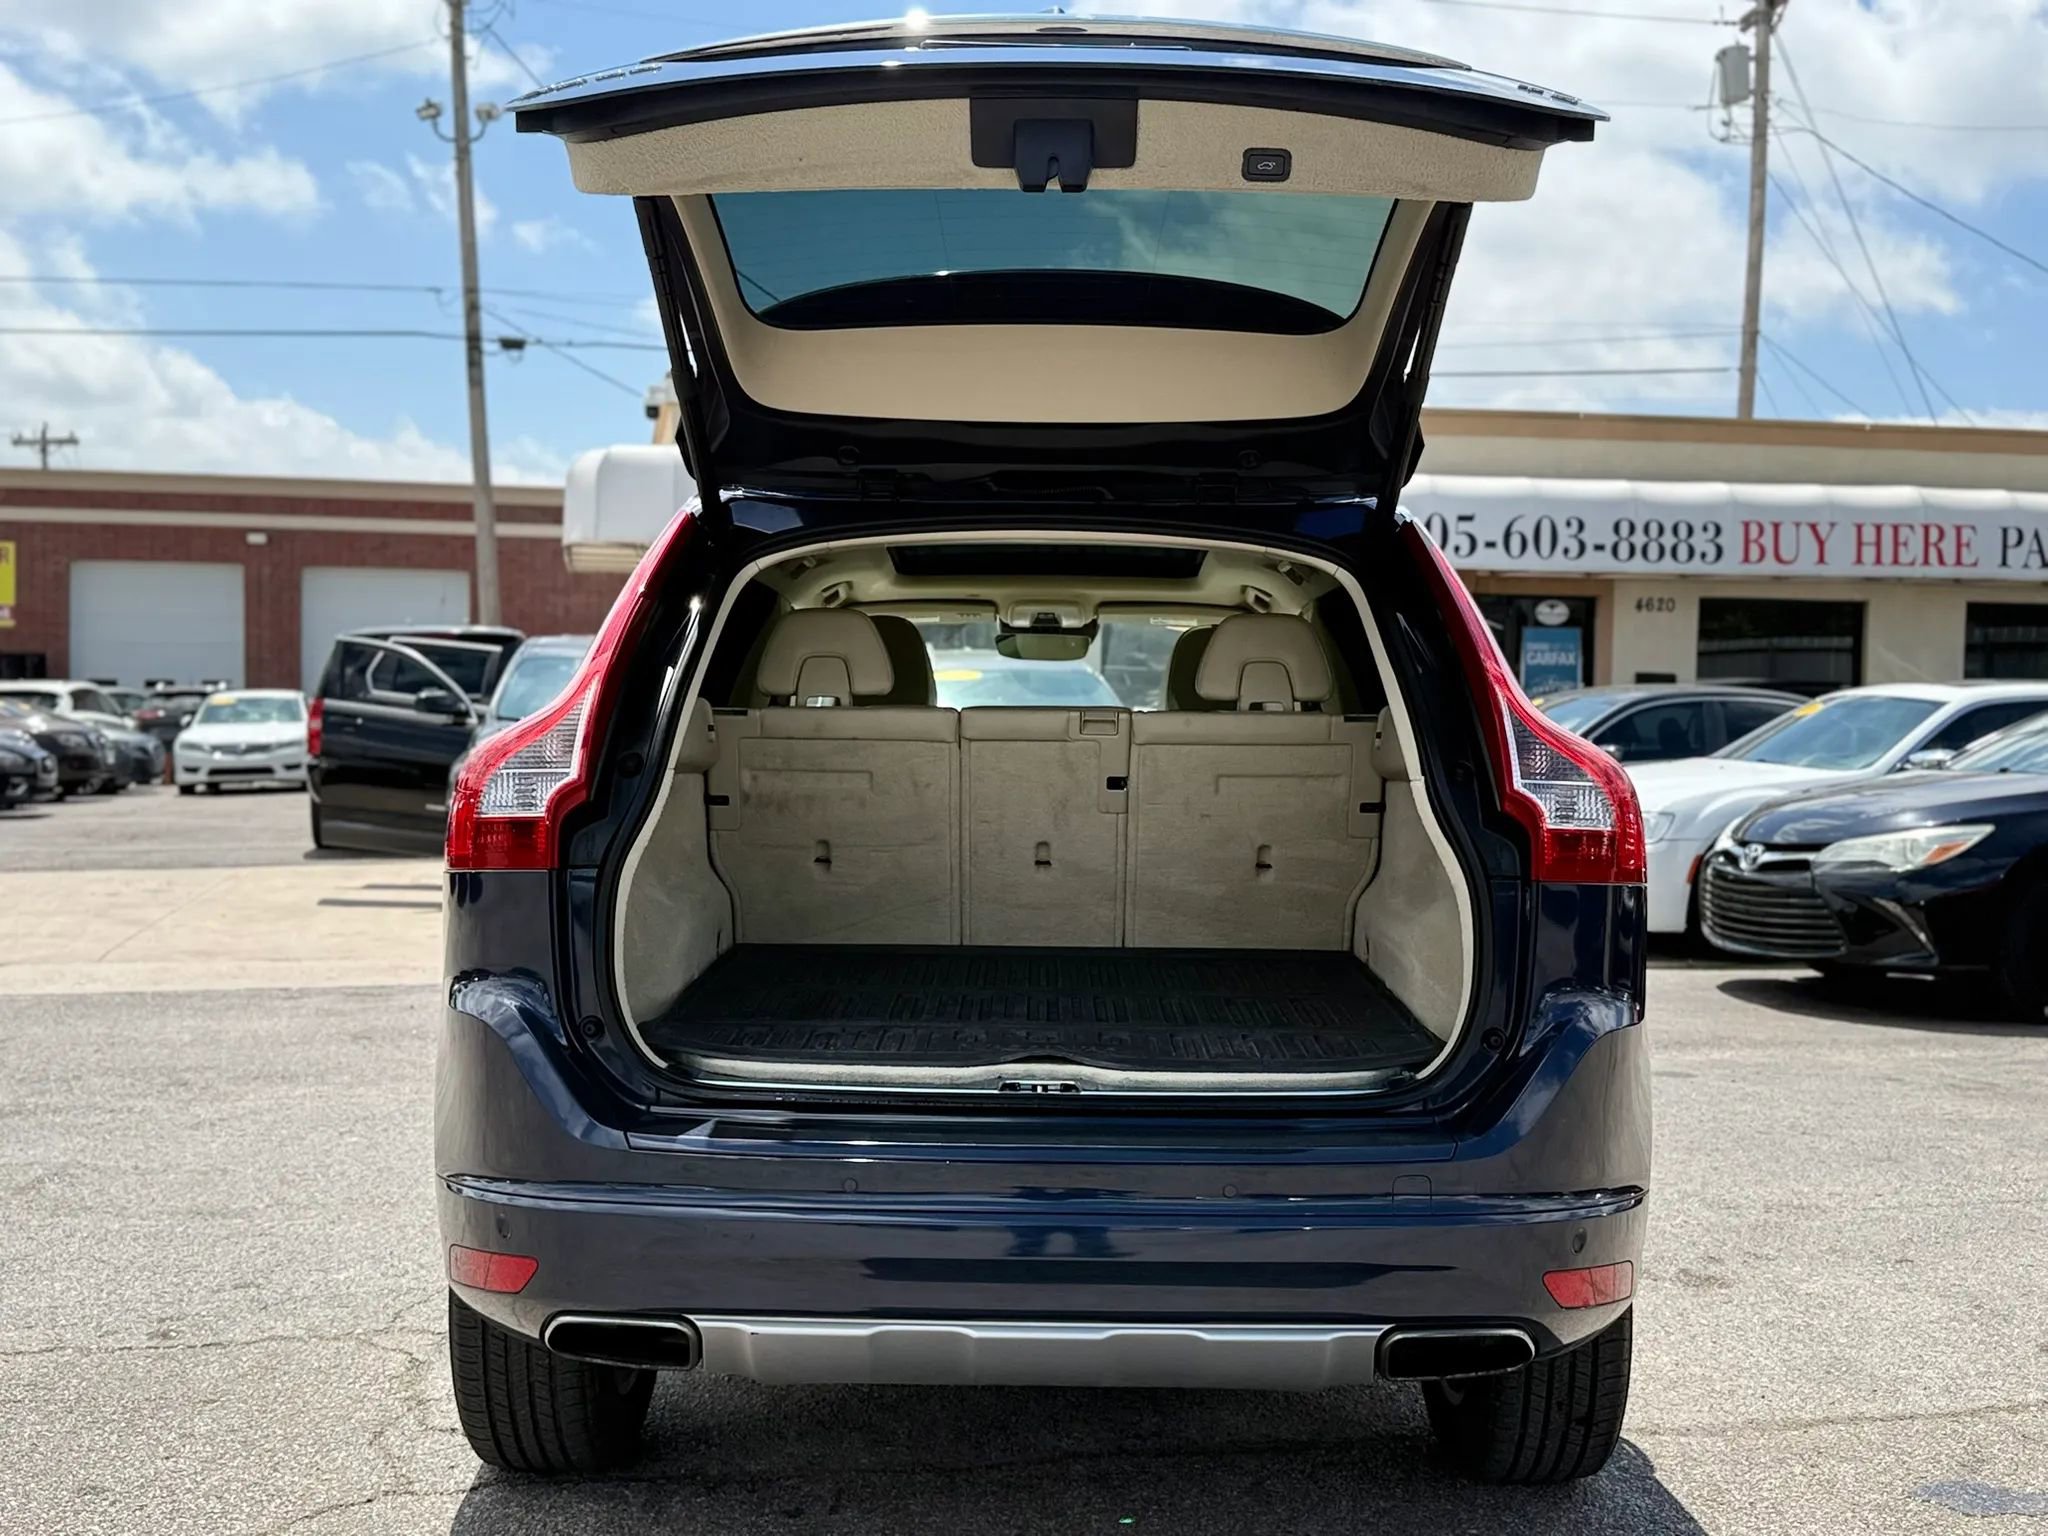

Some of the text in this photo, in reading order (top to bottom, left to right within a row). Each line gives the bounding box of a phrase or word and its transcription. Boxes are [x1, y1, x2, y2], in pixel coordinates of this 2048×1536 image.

[1739, 520, 1838, 565] BUY
[1852, 522, 1979, 567] HERE
[1634, 598, 1676, 613] 4620
[1526, 651, 1577, 666] CARFAX
